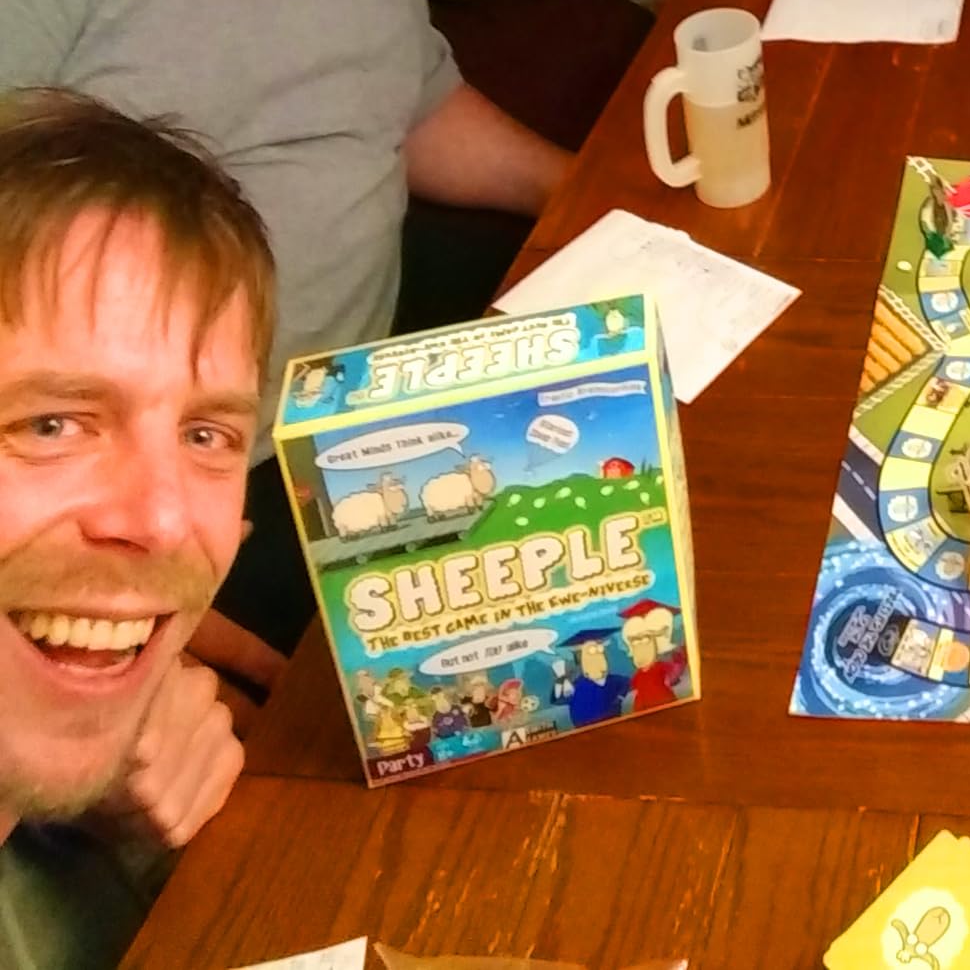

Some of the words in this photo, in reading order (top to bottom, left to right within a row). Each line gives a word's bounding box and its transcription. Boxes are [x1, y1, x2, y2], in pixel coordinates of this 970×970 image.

[367, 327, 580, 400] SHEEPLE
[350, 515, 642, 632] SHEEPLE
[366, 635, 399, 652] THE
[402, 624, 441, 642] BEST
[494, 609, 512, 623] IN
[515, 600, 545, 617] THE
[547, 573, 650, 609] EWE-NIVERSE
[376, 749, 426, 777] Party
